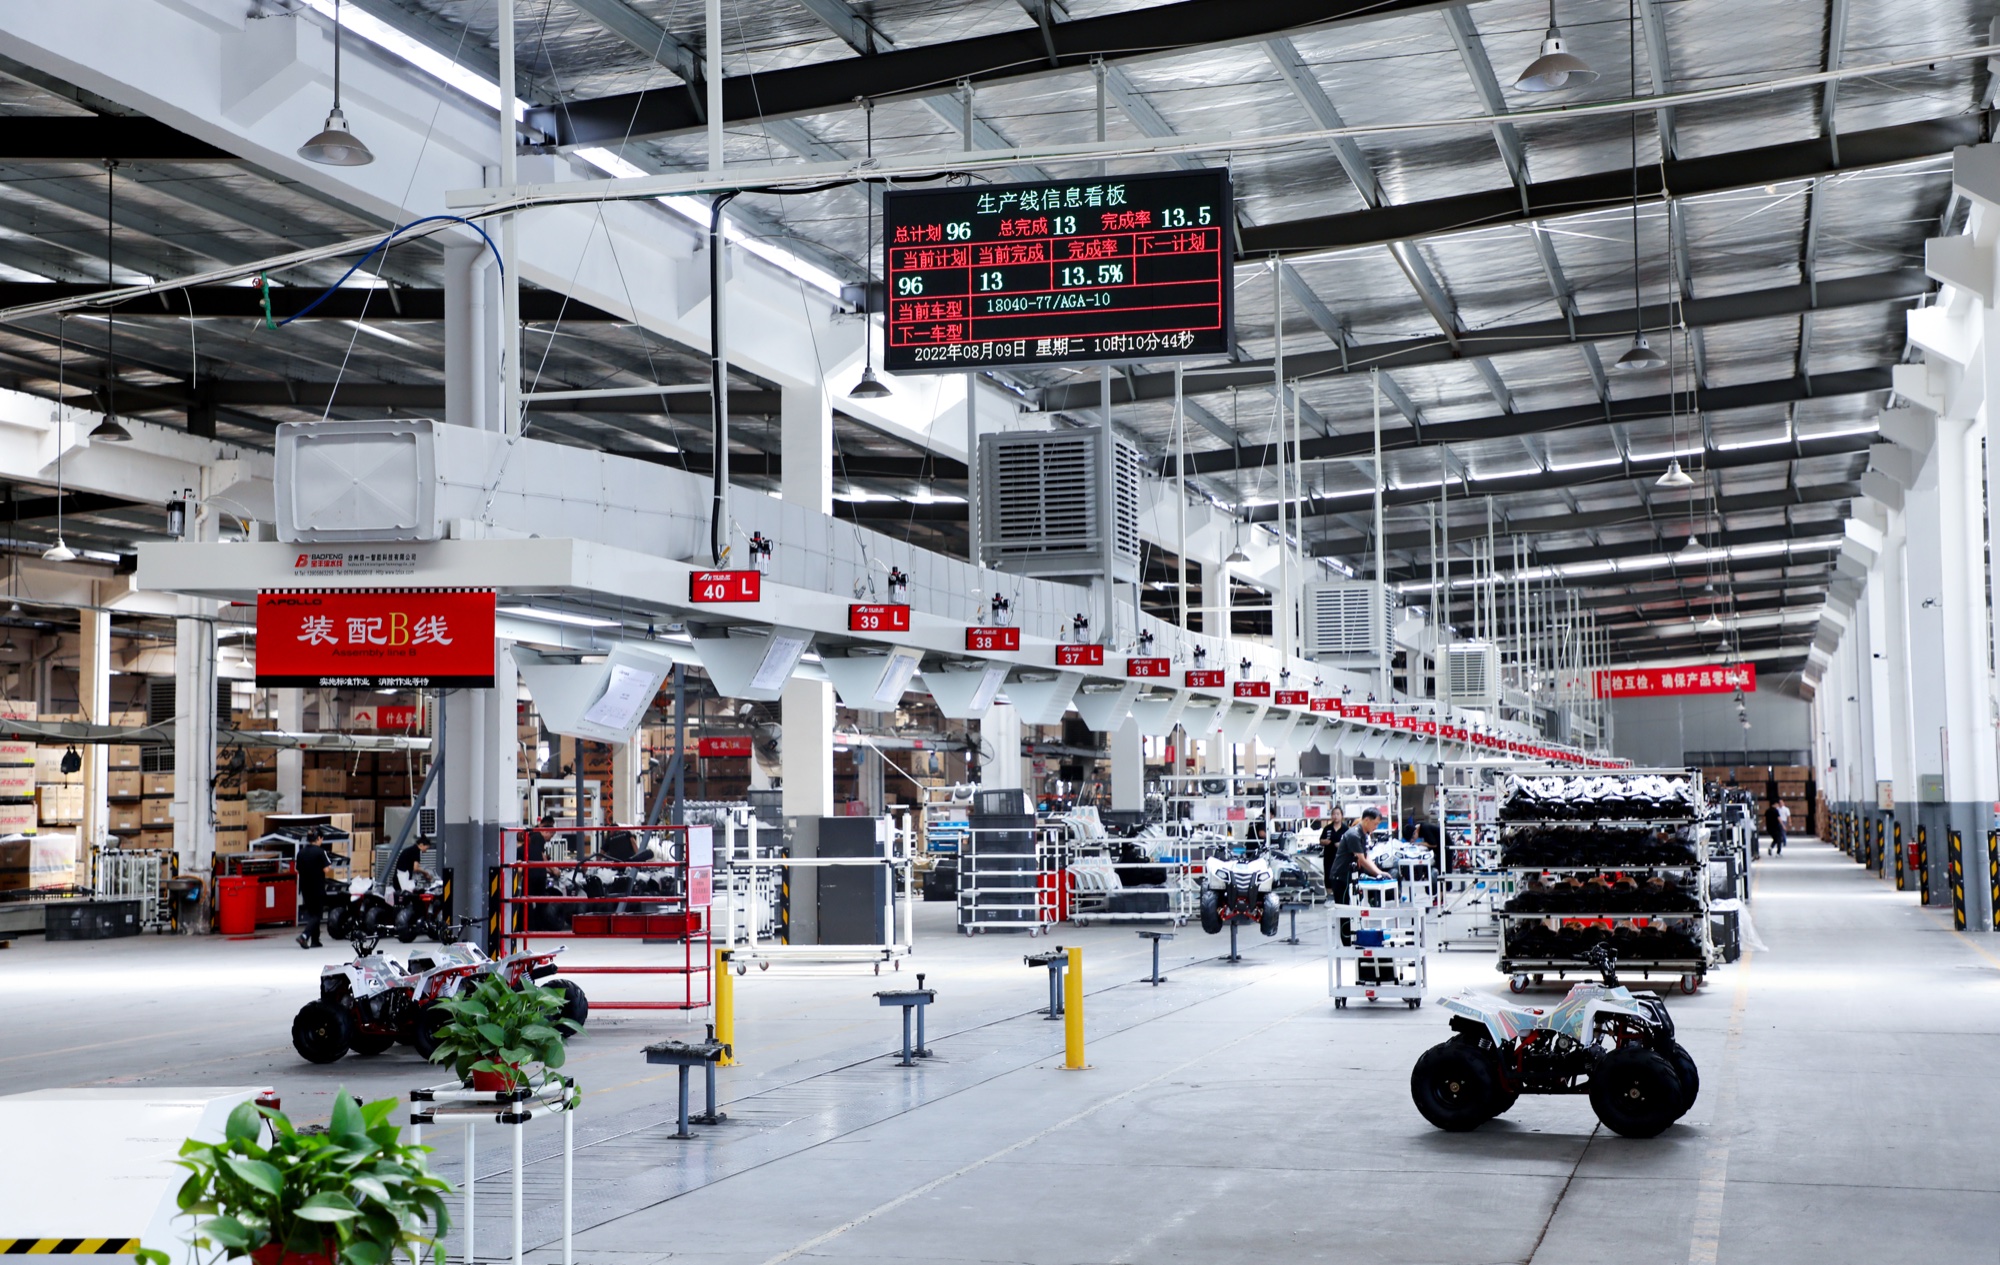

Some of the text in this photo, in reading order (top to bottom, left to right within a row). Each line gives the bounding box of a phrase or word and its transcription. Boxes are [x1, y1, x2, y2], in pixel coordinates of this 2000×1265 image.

[976, 184, 1127, 214] 生产线信息看板
[998, 215, 1077, 237] 总完成 13
[1100, 206, 1212, 231] 完成率 13.5
[893, 221, 972, 244] 总计划 96
[1137, 232, 1206, 252] 下一计划
[903, 247, 967, 269] 当前计划
[978, 243, 1045, 265] 当前完成
[1067, 239, 1119, 260] 完成率
[898, 276, 923, 296] 96
[979, 271, 1003, 292] 13
[1061, 264, 1124, 287] 13.5%
[898, 299, 963, 321] 当前车型
[986, 292, 1111, 313] 18040-77/AGA-10
[898, 323, 963, 344] 下一车型
[914, 330, 1195, 362] 2022年08月09日 星期二 10时10分44秒
[703, 584, 725, 599] 40
[742, 577, 753, 595] L
[266, 598, 322, 606] APOLLO
[861, 611, 903, 629] 39 L
[976, 633, 1014, 649] 38 L
[332, 648, 417, 657] Assembly line B
[1065, 653, 1079, 664] 37
[1090, 649, 1099, 661] L
[1135, 666, 1148, 675] 36
[1158, 662, 1166, 673] L
[1192, 677, 1205, 686] 35
[1213, 674, 1220, 684] L
[1240, 685, 1266, 696] 34 L
[1281, 693, 1305, 704] 33 L
[1315, 700, 1339, 711] 32 L
[1361, 708, 1367, 716] L
